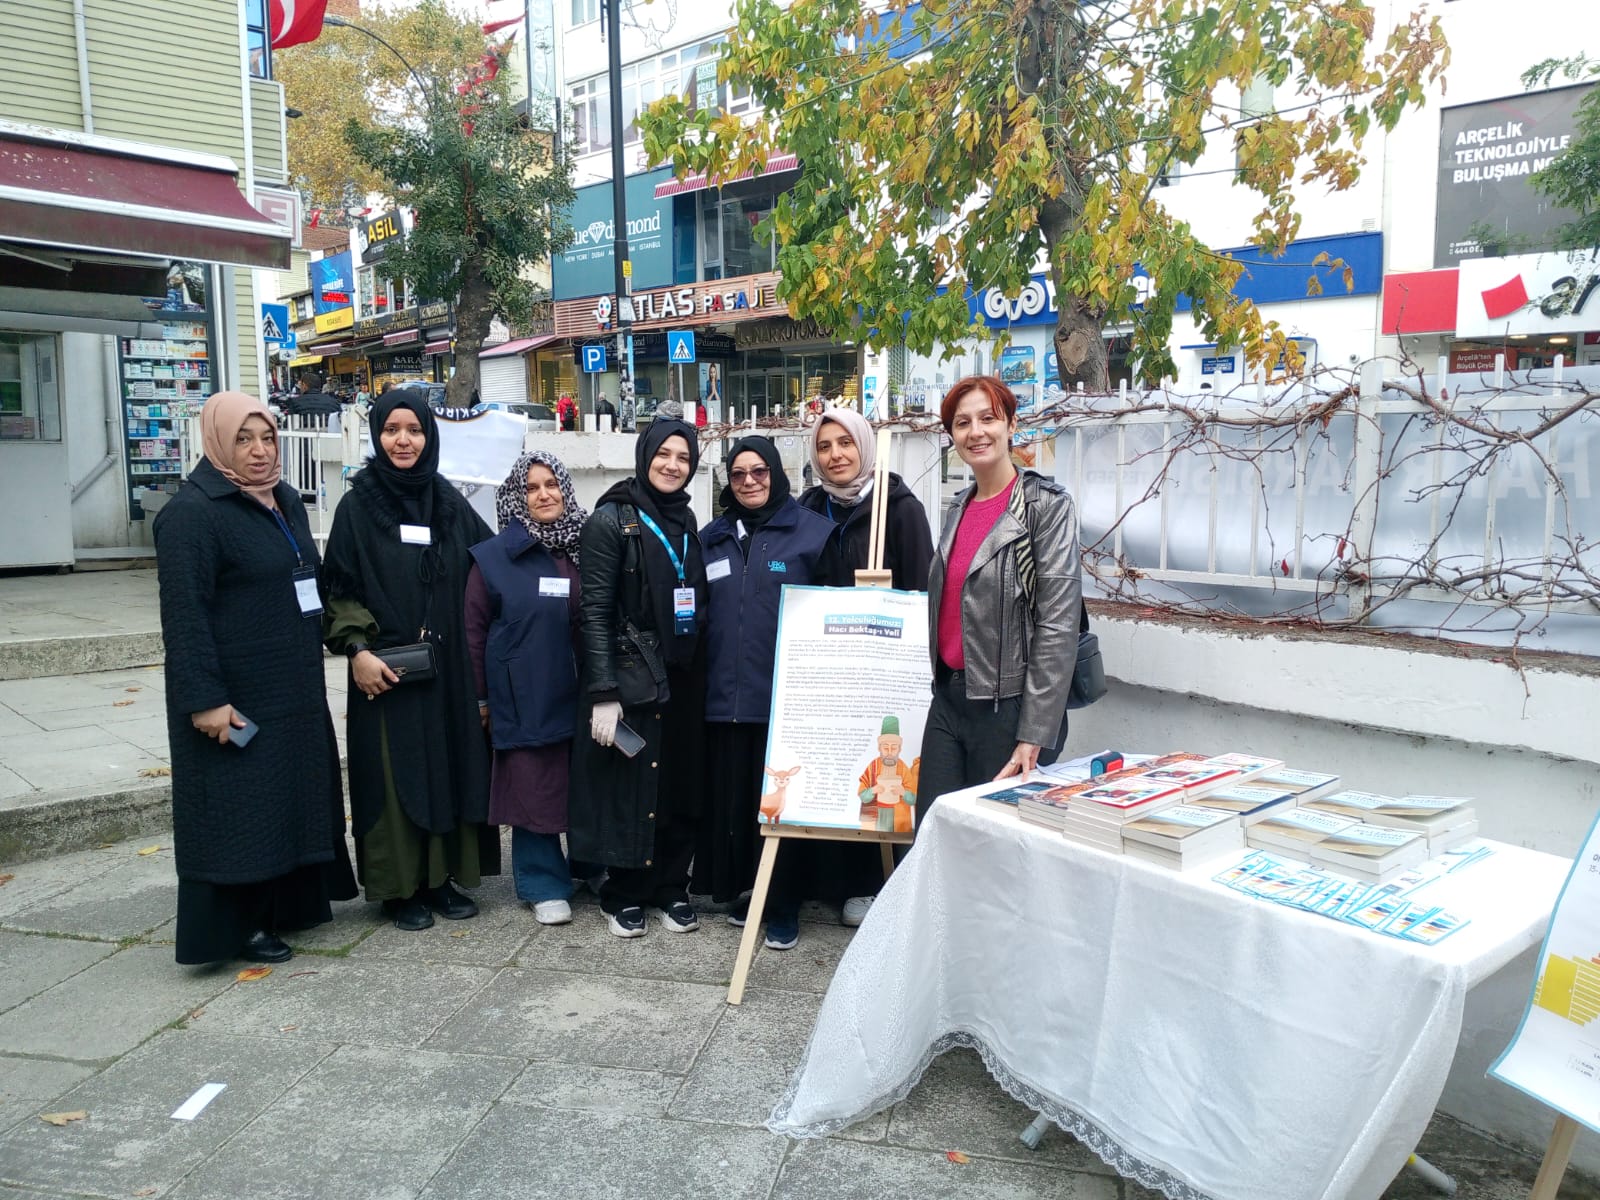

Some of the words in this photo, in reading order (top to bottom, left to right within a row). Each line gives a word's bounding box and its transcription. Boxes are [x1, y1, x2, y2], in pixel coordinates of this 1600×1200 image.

[1456, 121, 1523, 146] ARÇELİK
[1455, 135, 1571, 165] TEKNOLOJİYLE
[1453, 161, 1530, 183] BULUŞMA
[605, 210, 661, 240] dmond
[587, 348, 601, 370] P
[884, 629, 900, 637] Veli
